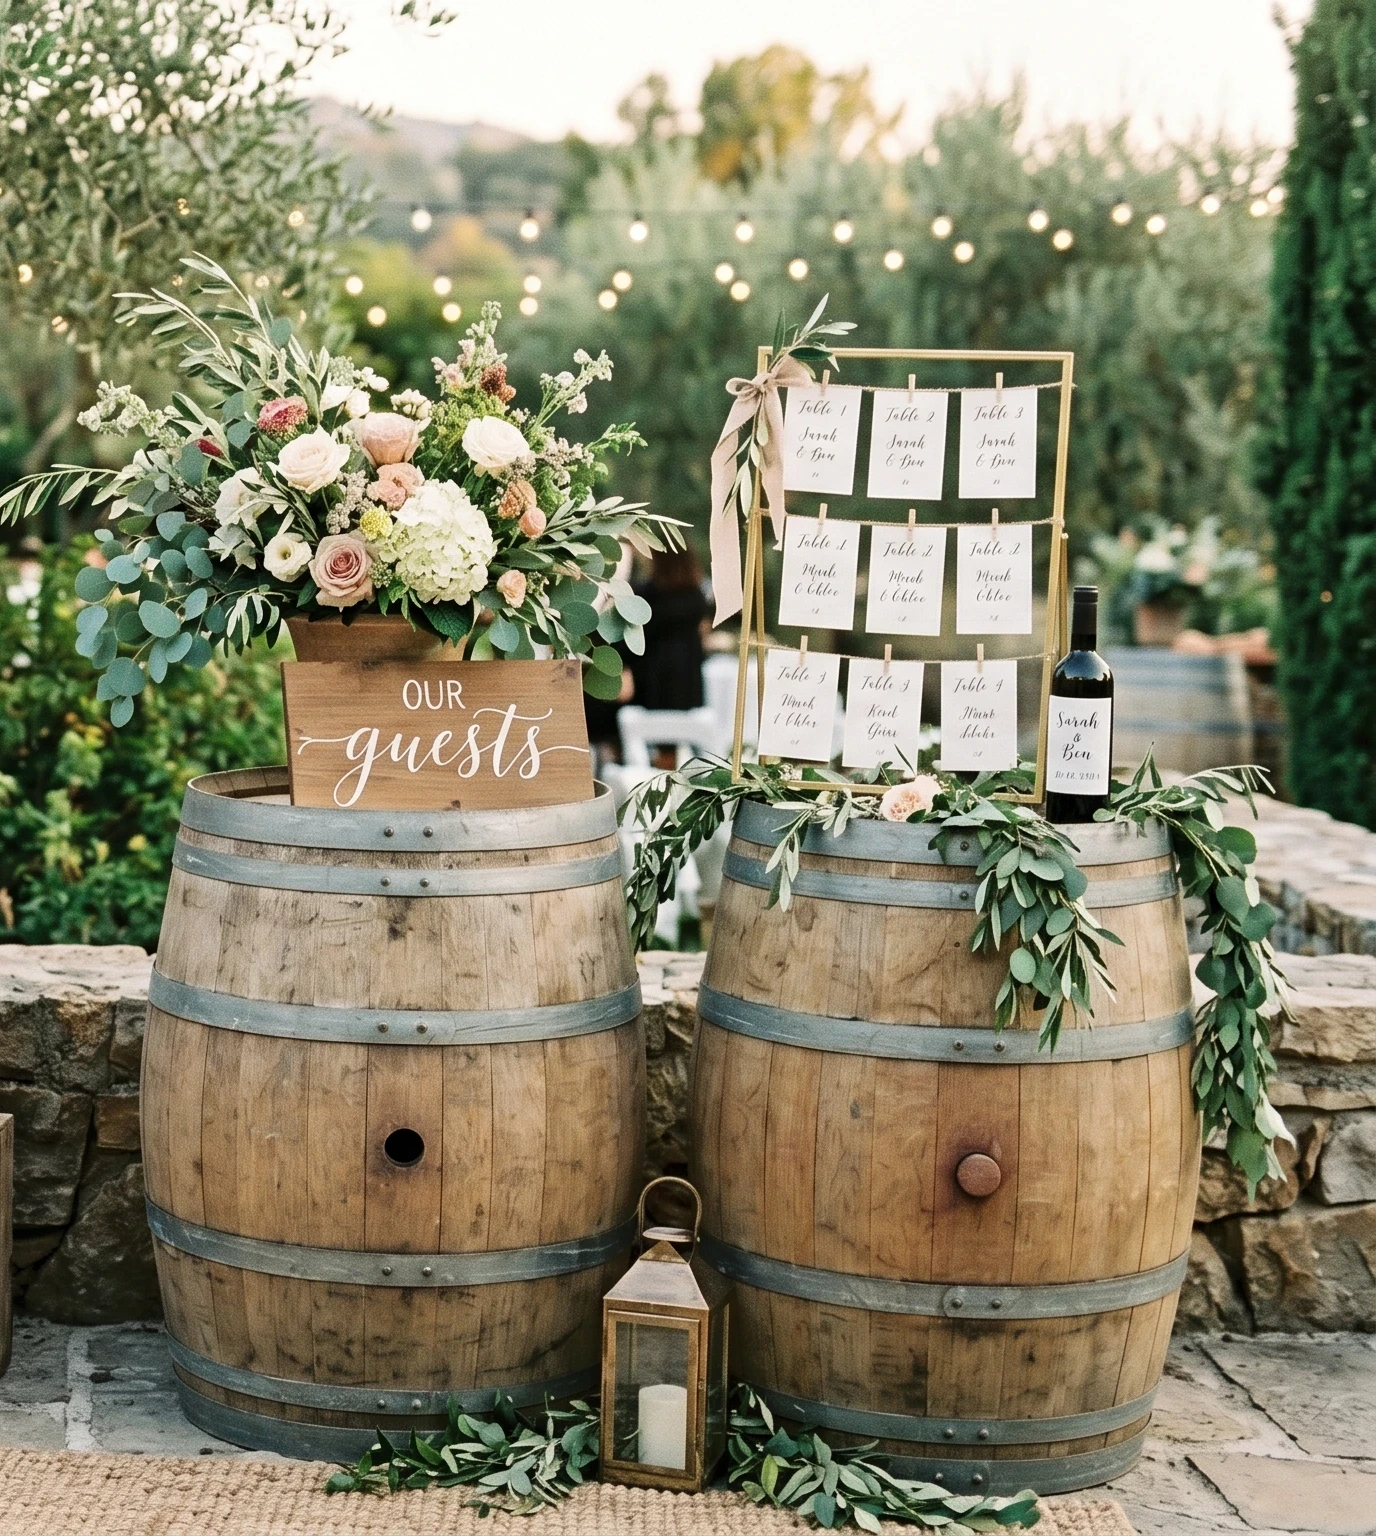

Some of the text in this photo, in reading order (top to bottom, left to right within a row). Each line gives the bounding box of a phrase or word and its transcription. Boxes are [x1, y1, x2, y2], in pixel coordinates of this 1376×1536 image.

[926, 411, 935, 423] 2
[1015, 406, 1024, 419] 3
[886, 434, 925, 449] Sarah
[976, 432, 1016, 449] Sarah
[969, 541, 1004, 557] Table
[402, 679, 466, 710] OUR
[1056, 711, 1099, 729] Sarah
[297, 704, 590, 807] guests
[1062, 743, 1093, 761] Ben
